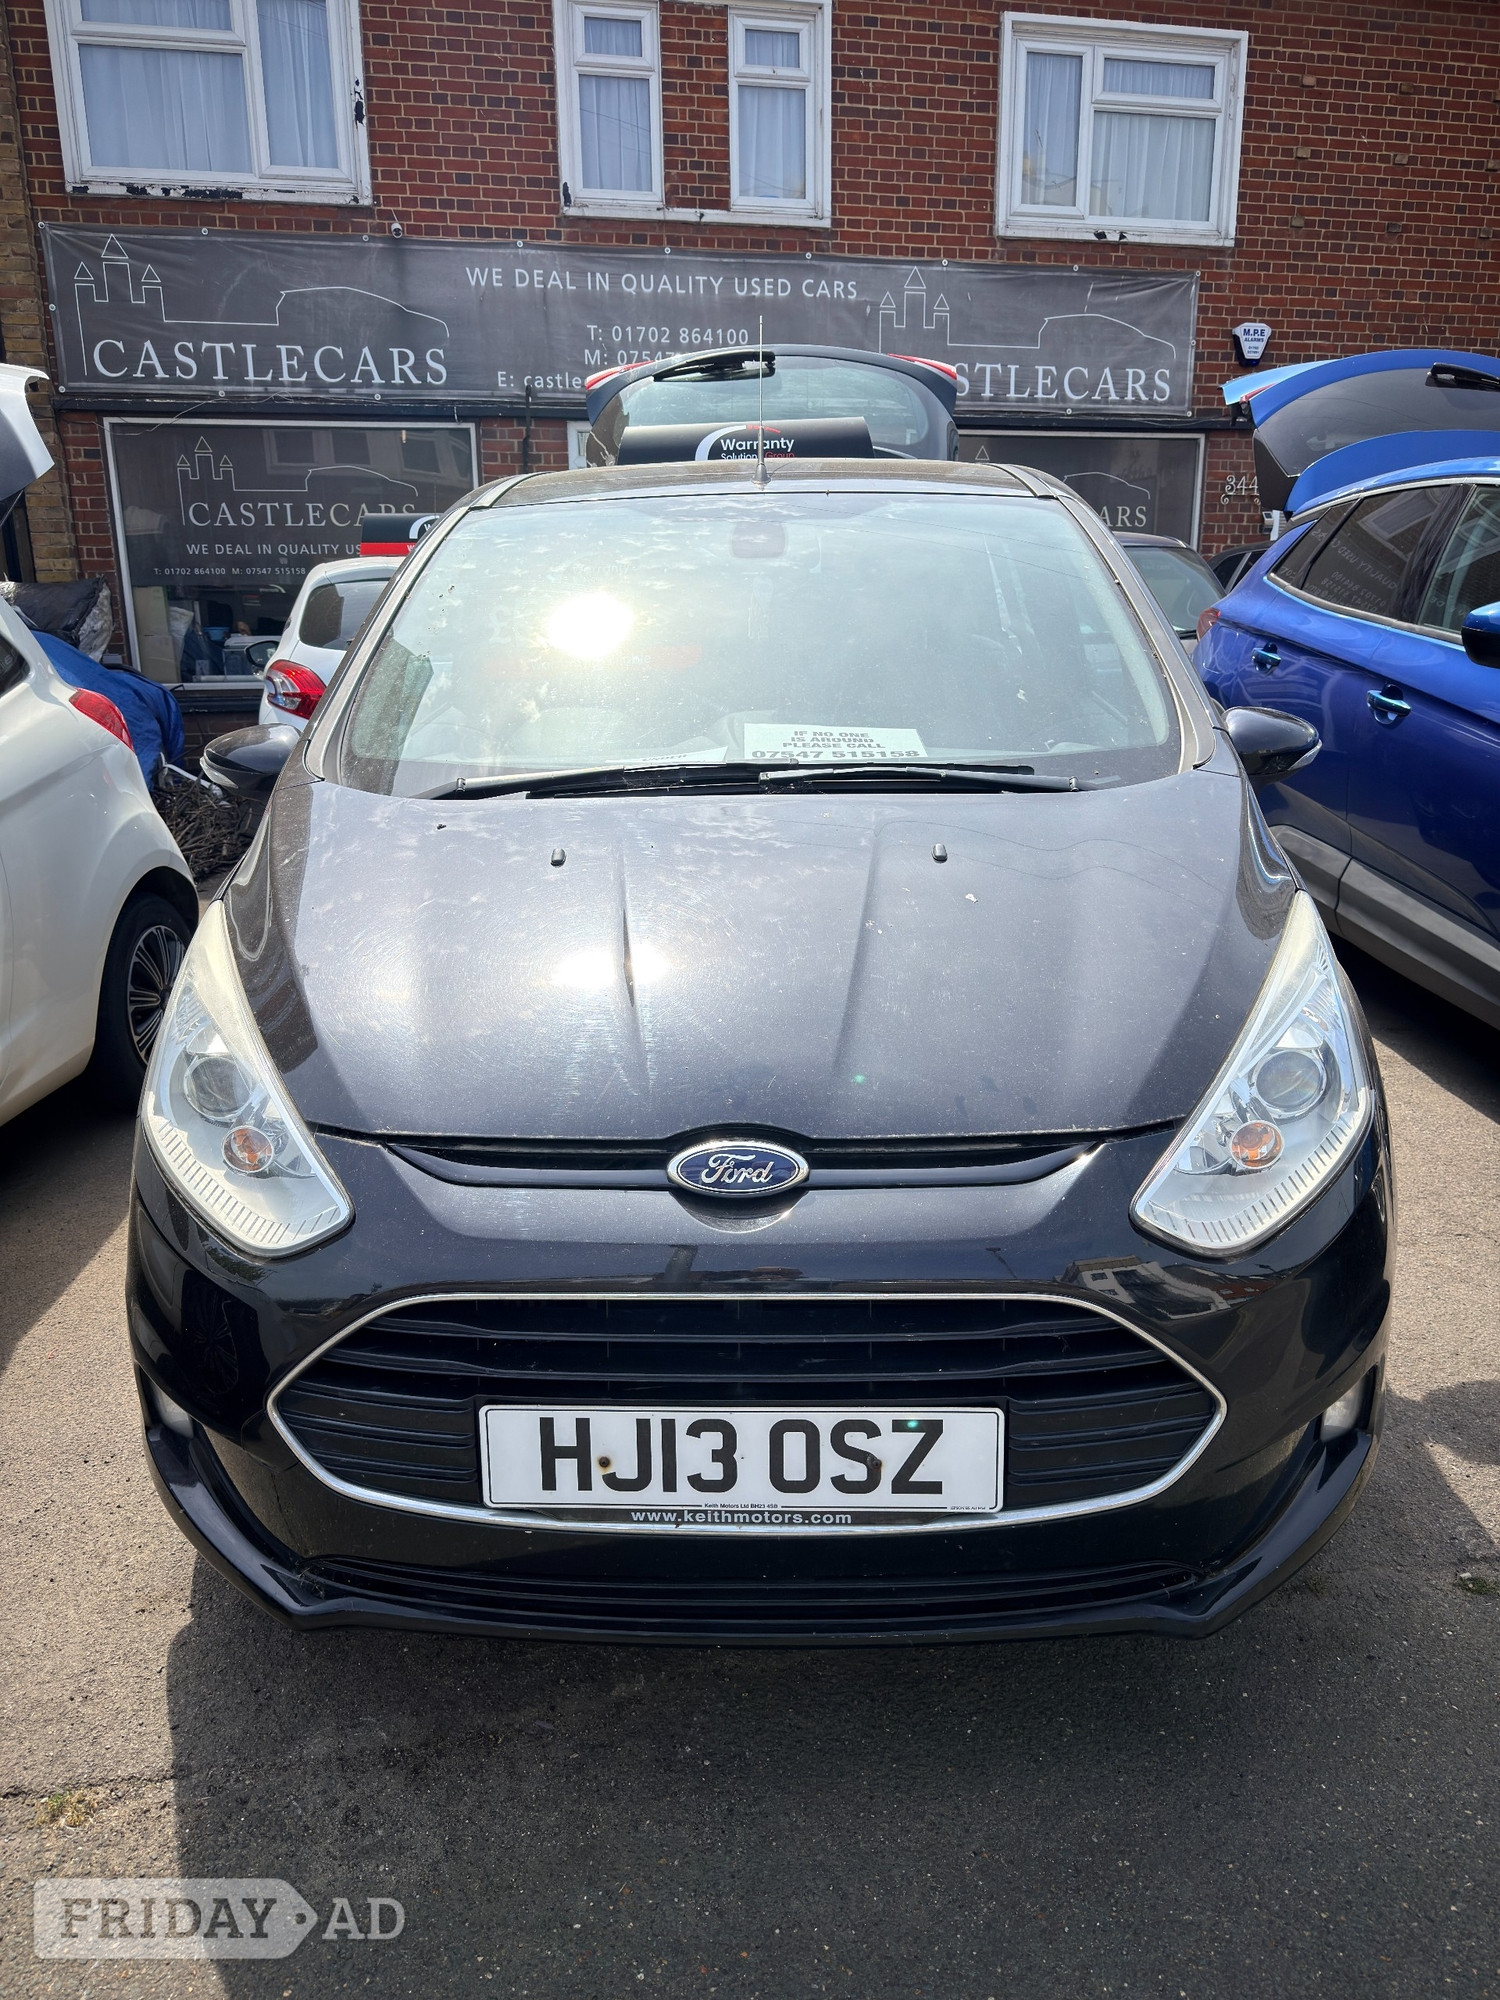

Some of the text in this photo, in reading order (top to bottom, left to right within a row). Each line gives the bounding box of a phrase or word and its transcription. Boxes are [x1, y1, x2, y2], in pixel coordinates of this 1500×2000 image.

[465, 267, 857, 299] WE DEAL IN QUALITY USED CARS
[587, 325, 749, 344] T: 01702 864100
[93, 339, 447, 385] CASTLECARS
[584, 349, 608, 365] M:
[497, 371, 590, 389] E: castle
[956, 363, 1170, 401] STLECARS
[720, 438, 795, 452] Warranty
[721, 452, 759, 460] Solution
[1225, 474, 1259, 495] 344
[187, 544, 209, 555] WE
[215, 544, 252, 555] DEAL
[258, 544, 271, 555] IN
[278, 544, 339, 556] QUALITY
[275, 567, 306, 575] 515158
[752, 750, 920, 759] 07547 515158
[701, 1153, 775, 1184] Ford
[539, 1417, 944, 1494] HJ13 OSZ
[631, 1510, 852, 1524] www.keithmotors.com
